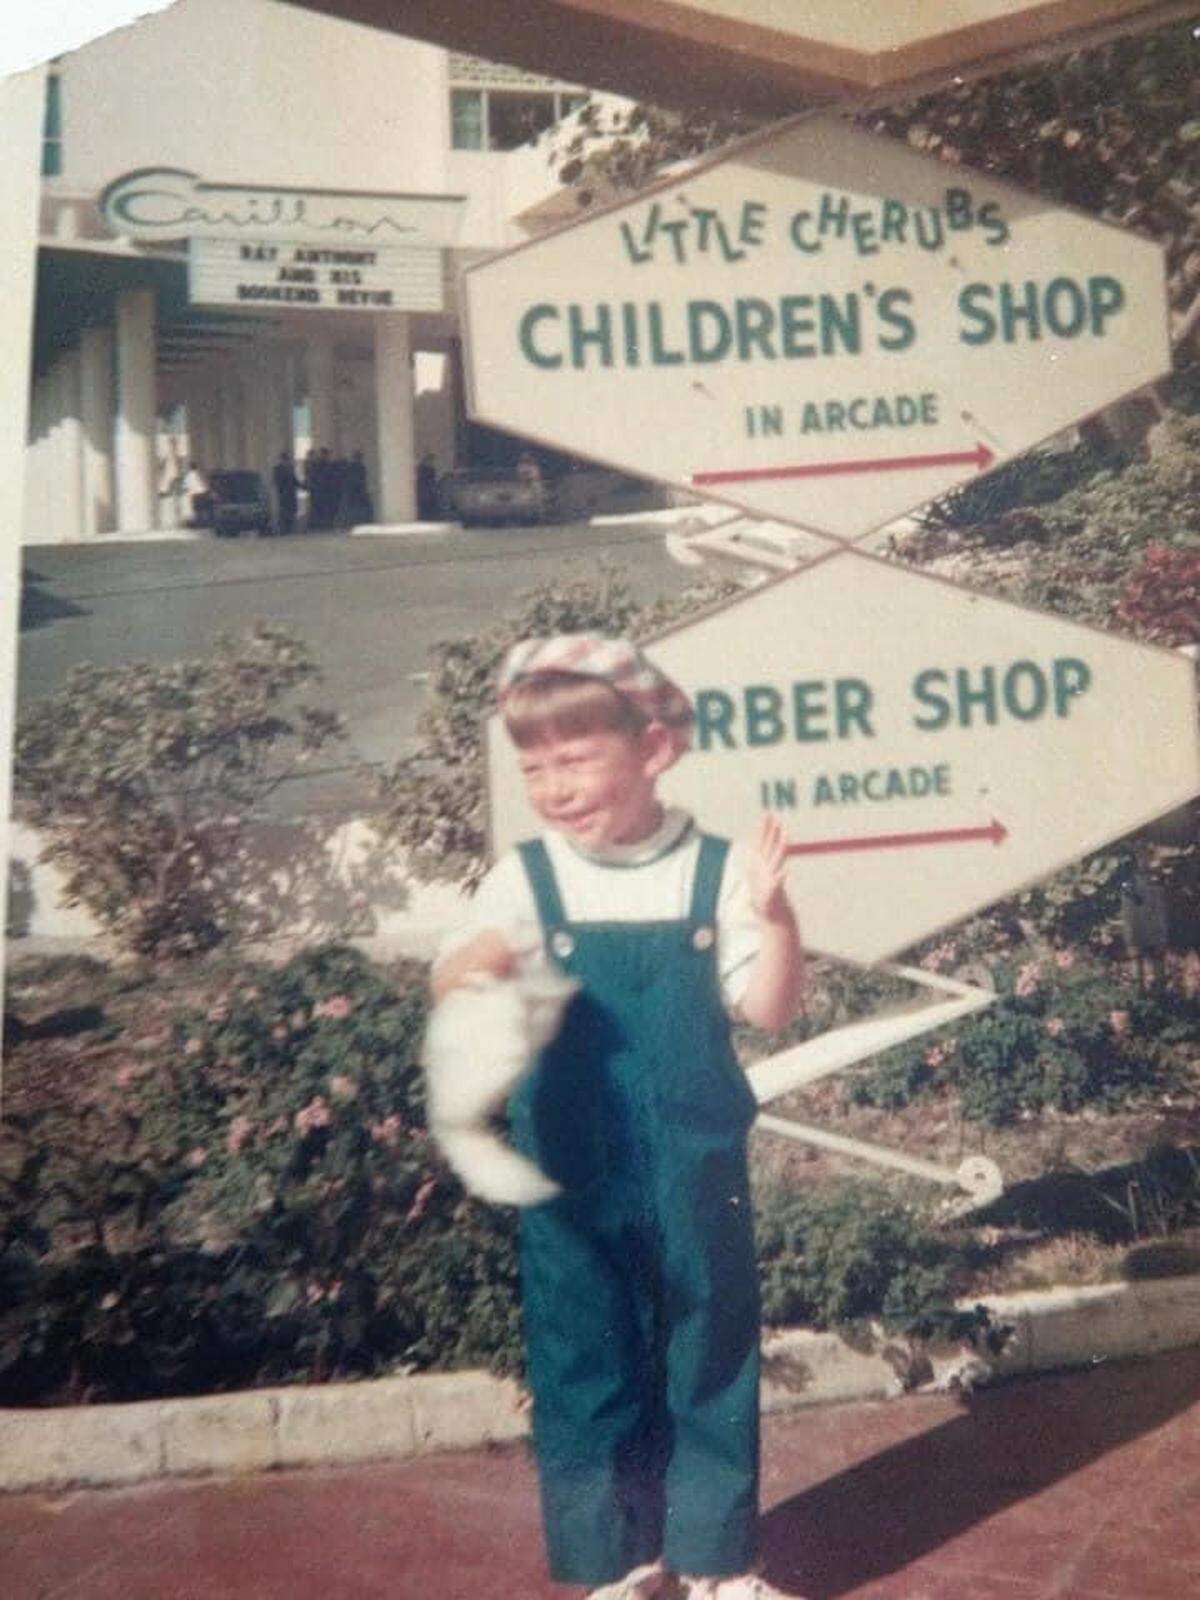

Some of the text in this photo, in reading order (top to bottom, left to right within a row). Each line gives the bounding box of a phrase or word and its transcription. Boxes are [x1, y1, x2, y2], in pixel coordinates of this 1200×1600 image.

[110, 186, 420, 234] Carillon
[619, 187, 1011, 264] LITTLE CHERUBS
[518, 276, 1124, 370] CHILDREN'S SHOP
[745, 393, 939, 438] IN ARCADE
[695, 656, 1093, 751] RBER SHOP
[760, 764, 952, 811] IN ARCADE
